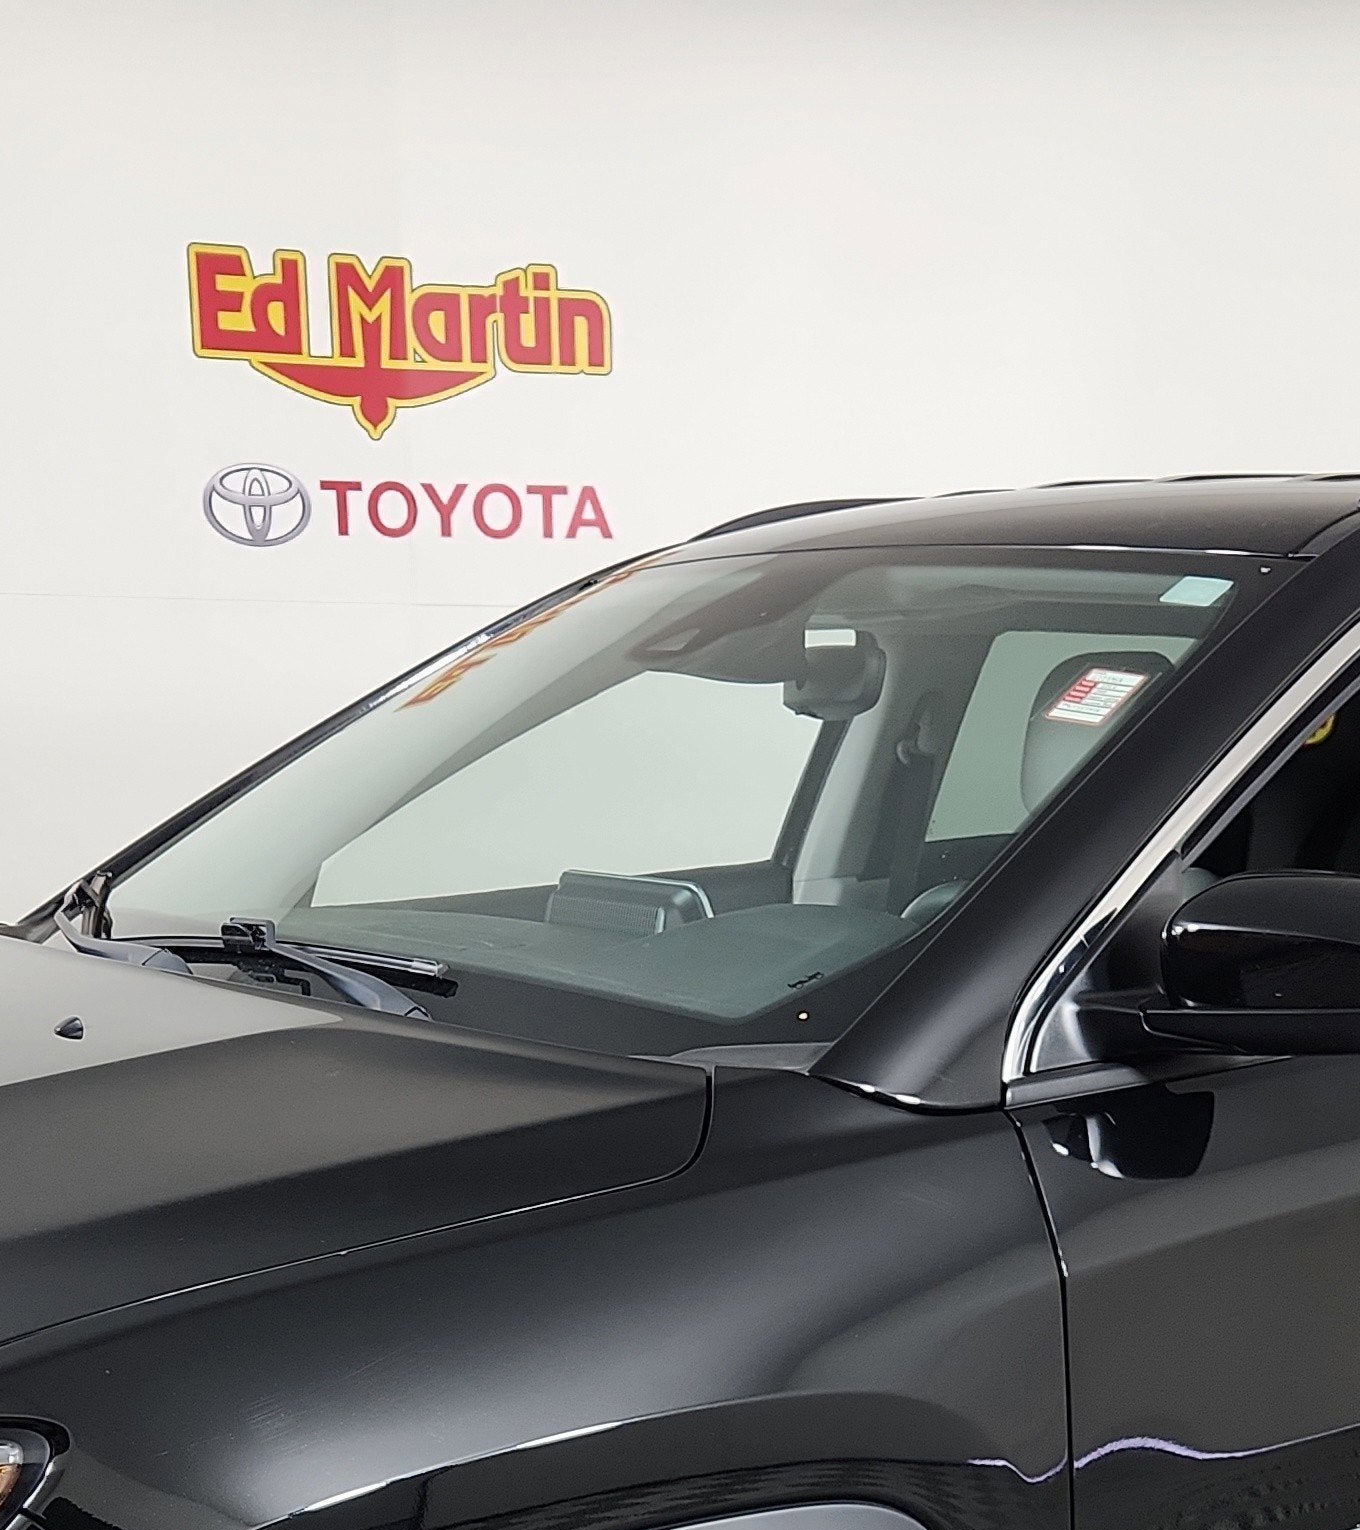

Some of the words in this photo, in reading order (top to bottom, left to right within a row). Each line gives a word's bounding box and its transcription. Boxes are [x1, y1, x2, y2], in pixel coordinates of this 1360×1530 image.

[193, 250, 304, 357] Ed
[334, 260, 609, 368] Martin
[319, 479, 614, 540] TOYOTA
